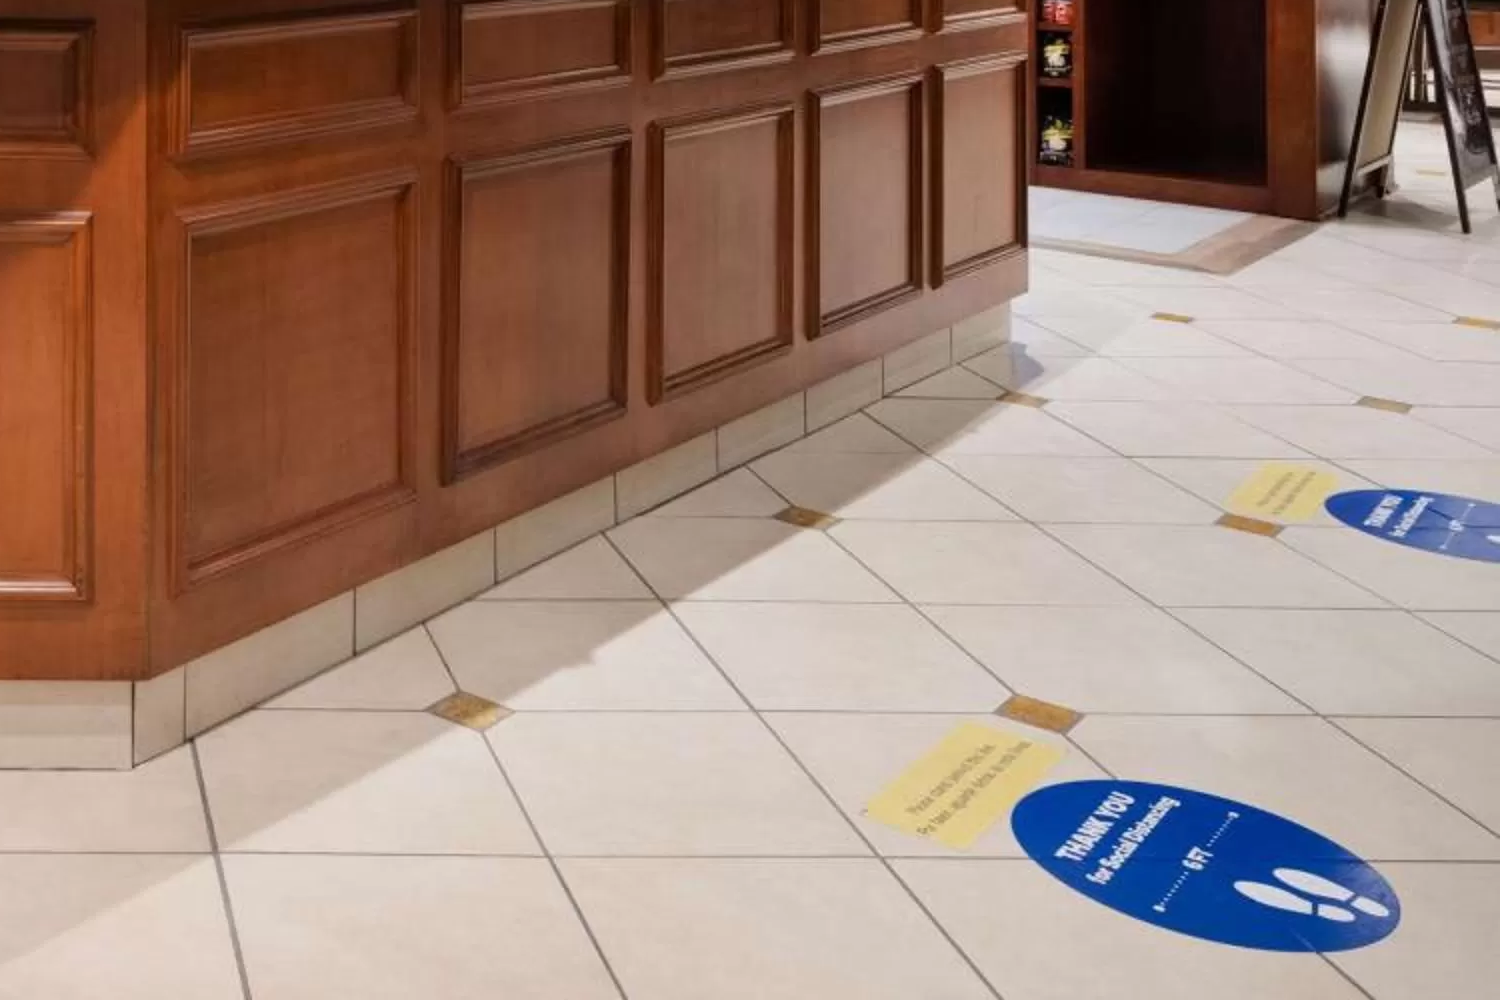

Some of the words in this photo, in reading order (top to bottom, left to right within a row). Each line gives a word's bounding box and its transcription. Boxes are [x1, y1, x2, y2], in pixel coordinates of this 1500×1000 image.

[1053, 815, 1115, 861] THANK
[1093, 791, 1136, 819] YOU
[1120, 796, 1182, 844] Distancing
[1098, 836, 1141, 870] Social
[1085, 867, 1115, 885] for
